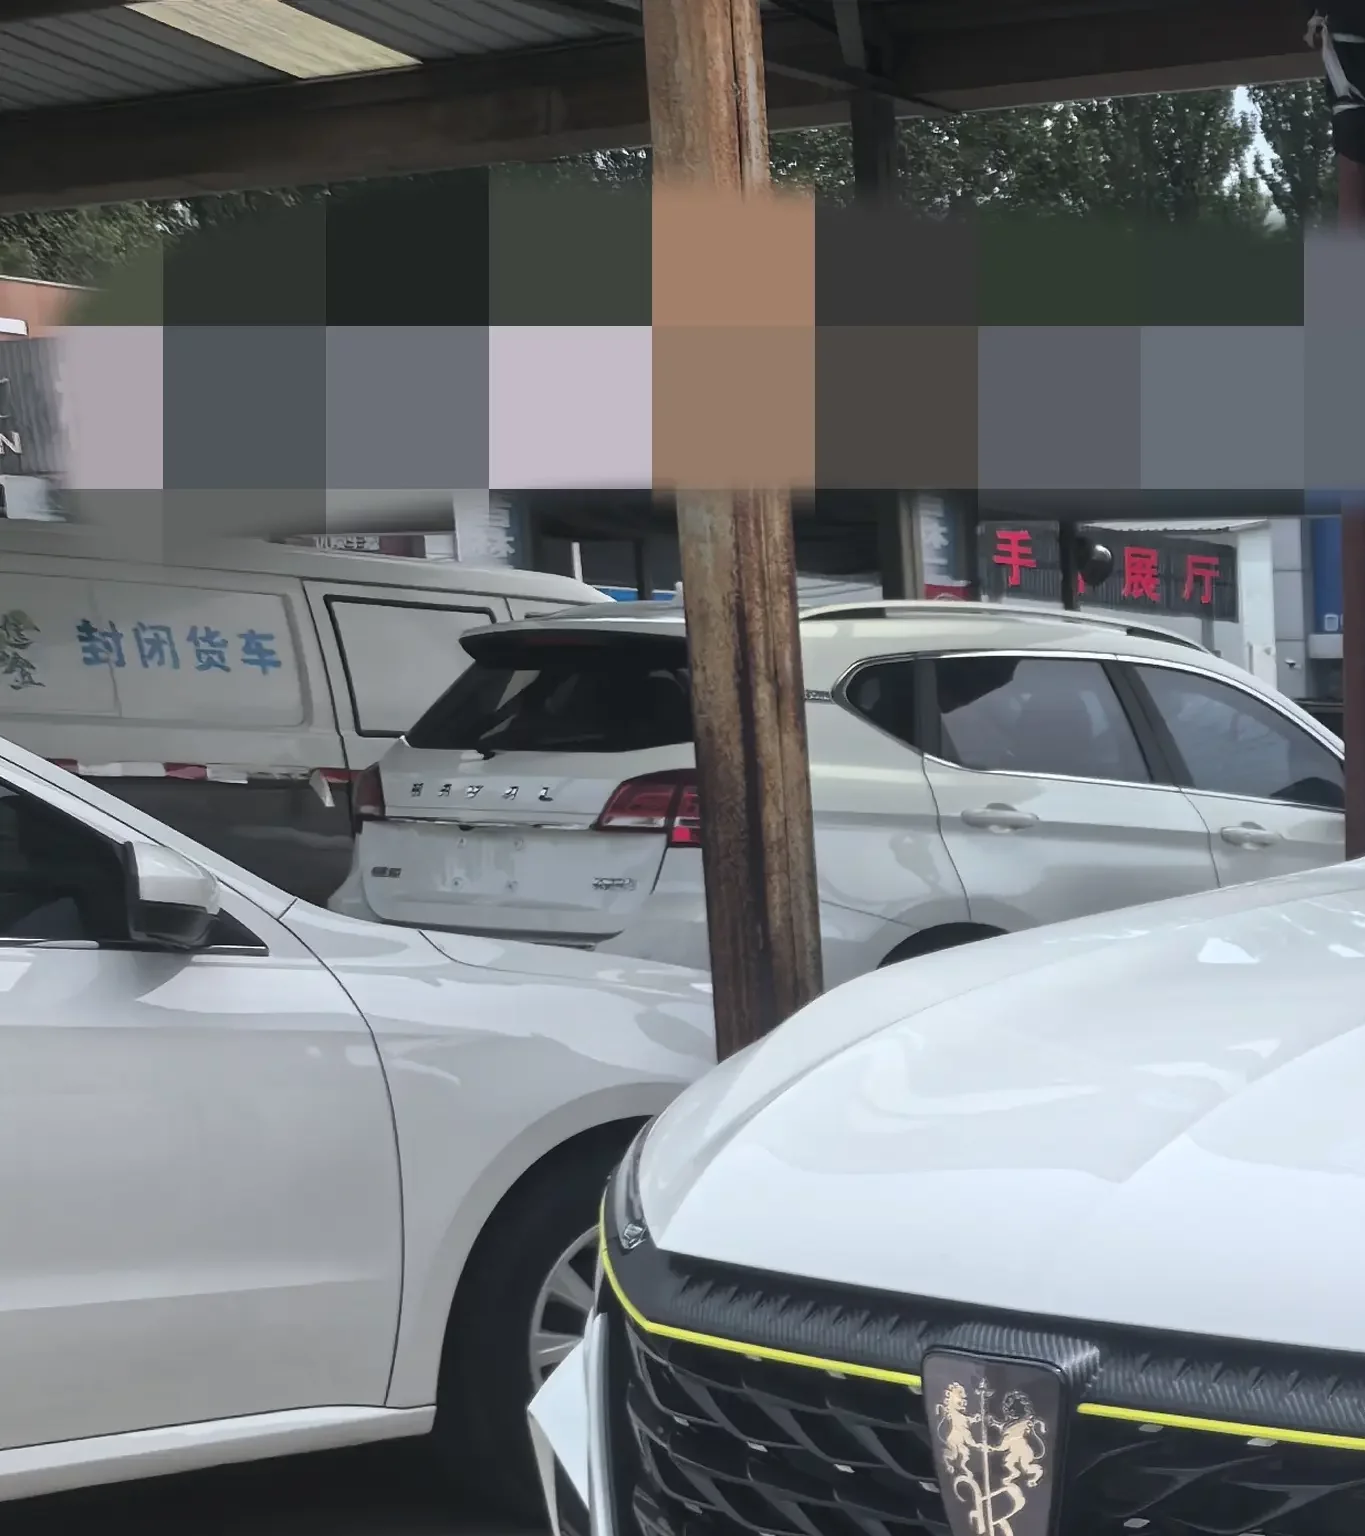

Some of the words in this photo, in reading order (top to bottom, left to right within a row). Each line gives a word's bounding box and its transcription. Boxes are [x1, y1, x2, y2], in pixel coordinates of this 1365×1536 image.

[992, 530, 1221, 604] 手展厅
[75, 618, 283, 676] 封闭货车
